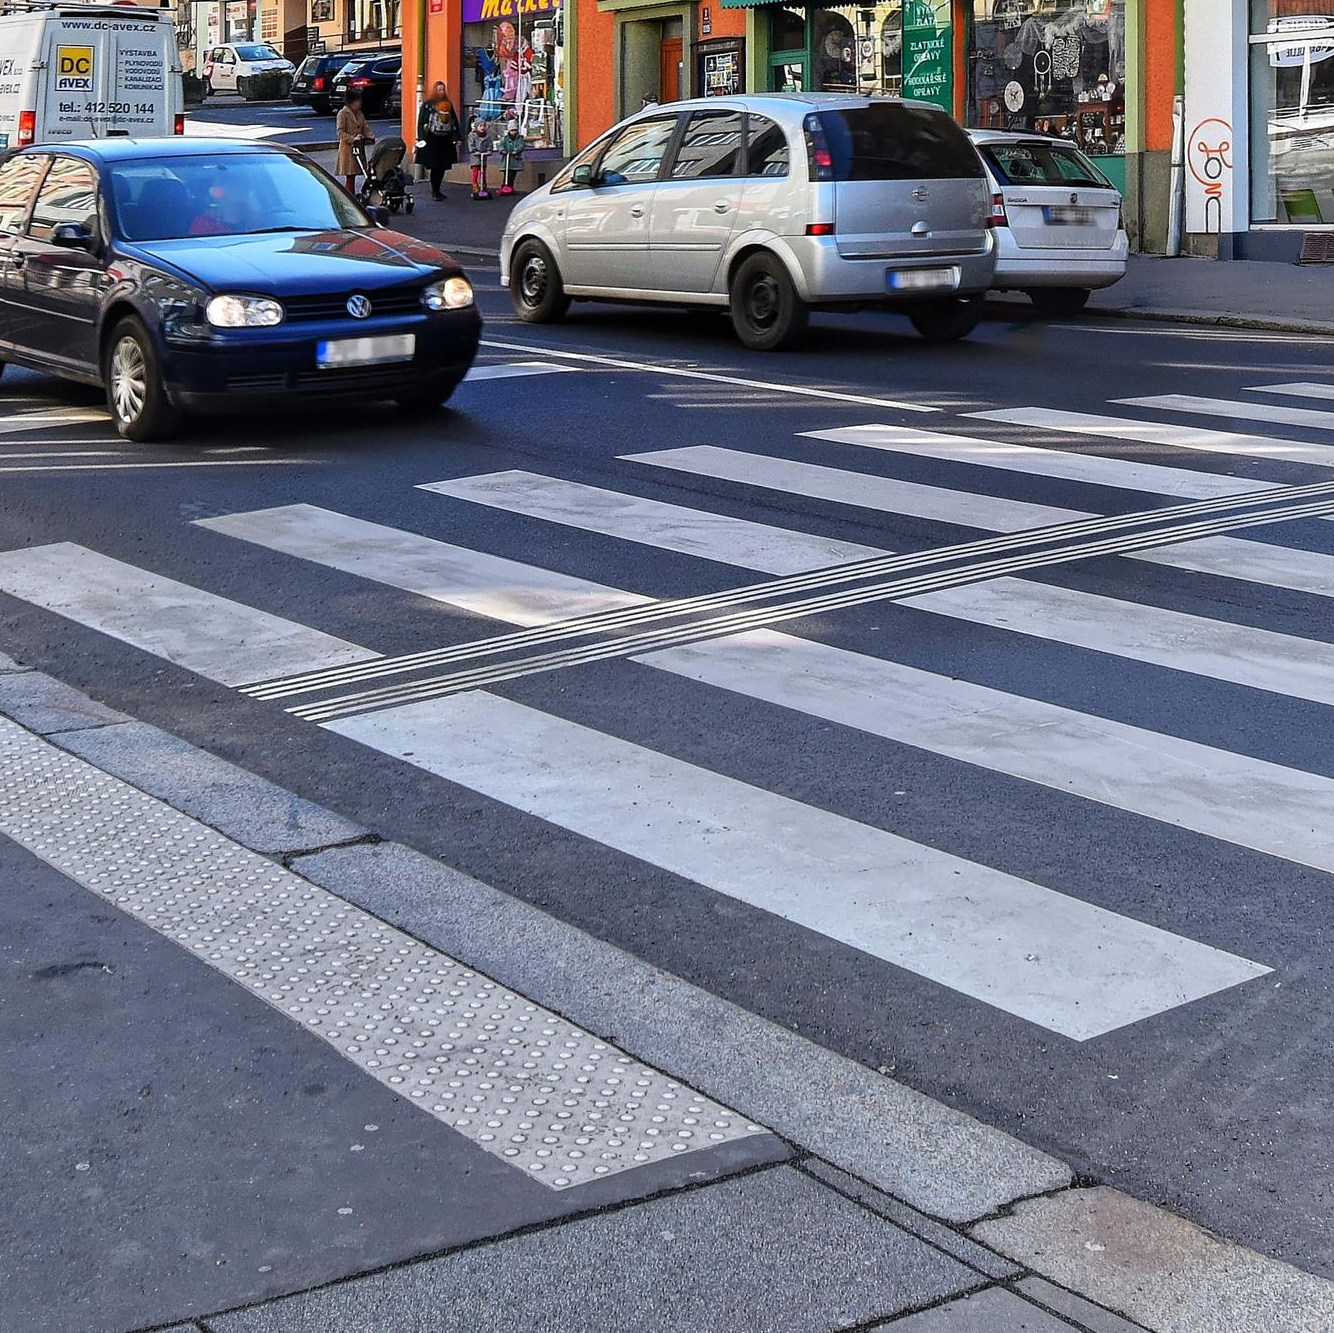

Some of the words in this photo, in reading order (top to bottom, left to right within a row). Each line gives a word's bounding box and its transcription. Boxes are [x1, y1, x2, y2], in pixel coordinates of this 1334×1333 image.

[61, 21, 156, 32] www.dc-avex.cz
[60, 57, 90, 74] DC
[59, 78, 90, 88] AVEX
[913, 86, 941, 97] OPRAVY
[59, 101, 81, 113] tel.:
[84, 102, 106, 114] 412
[108, 102, 130, 114] 520
[134, 103, 154, 114] 144
